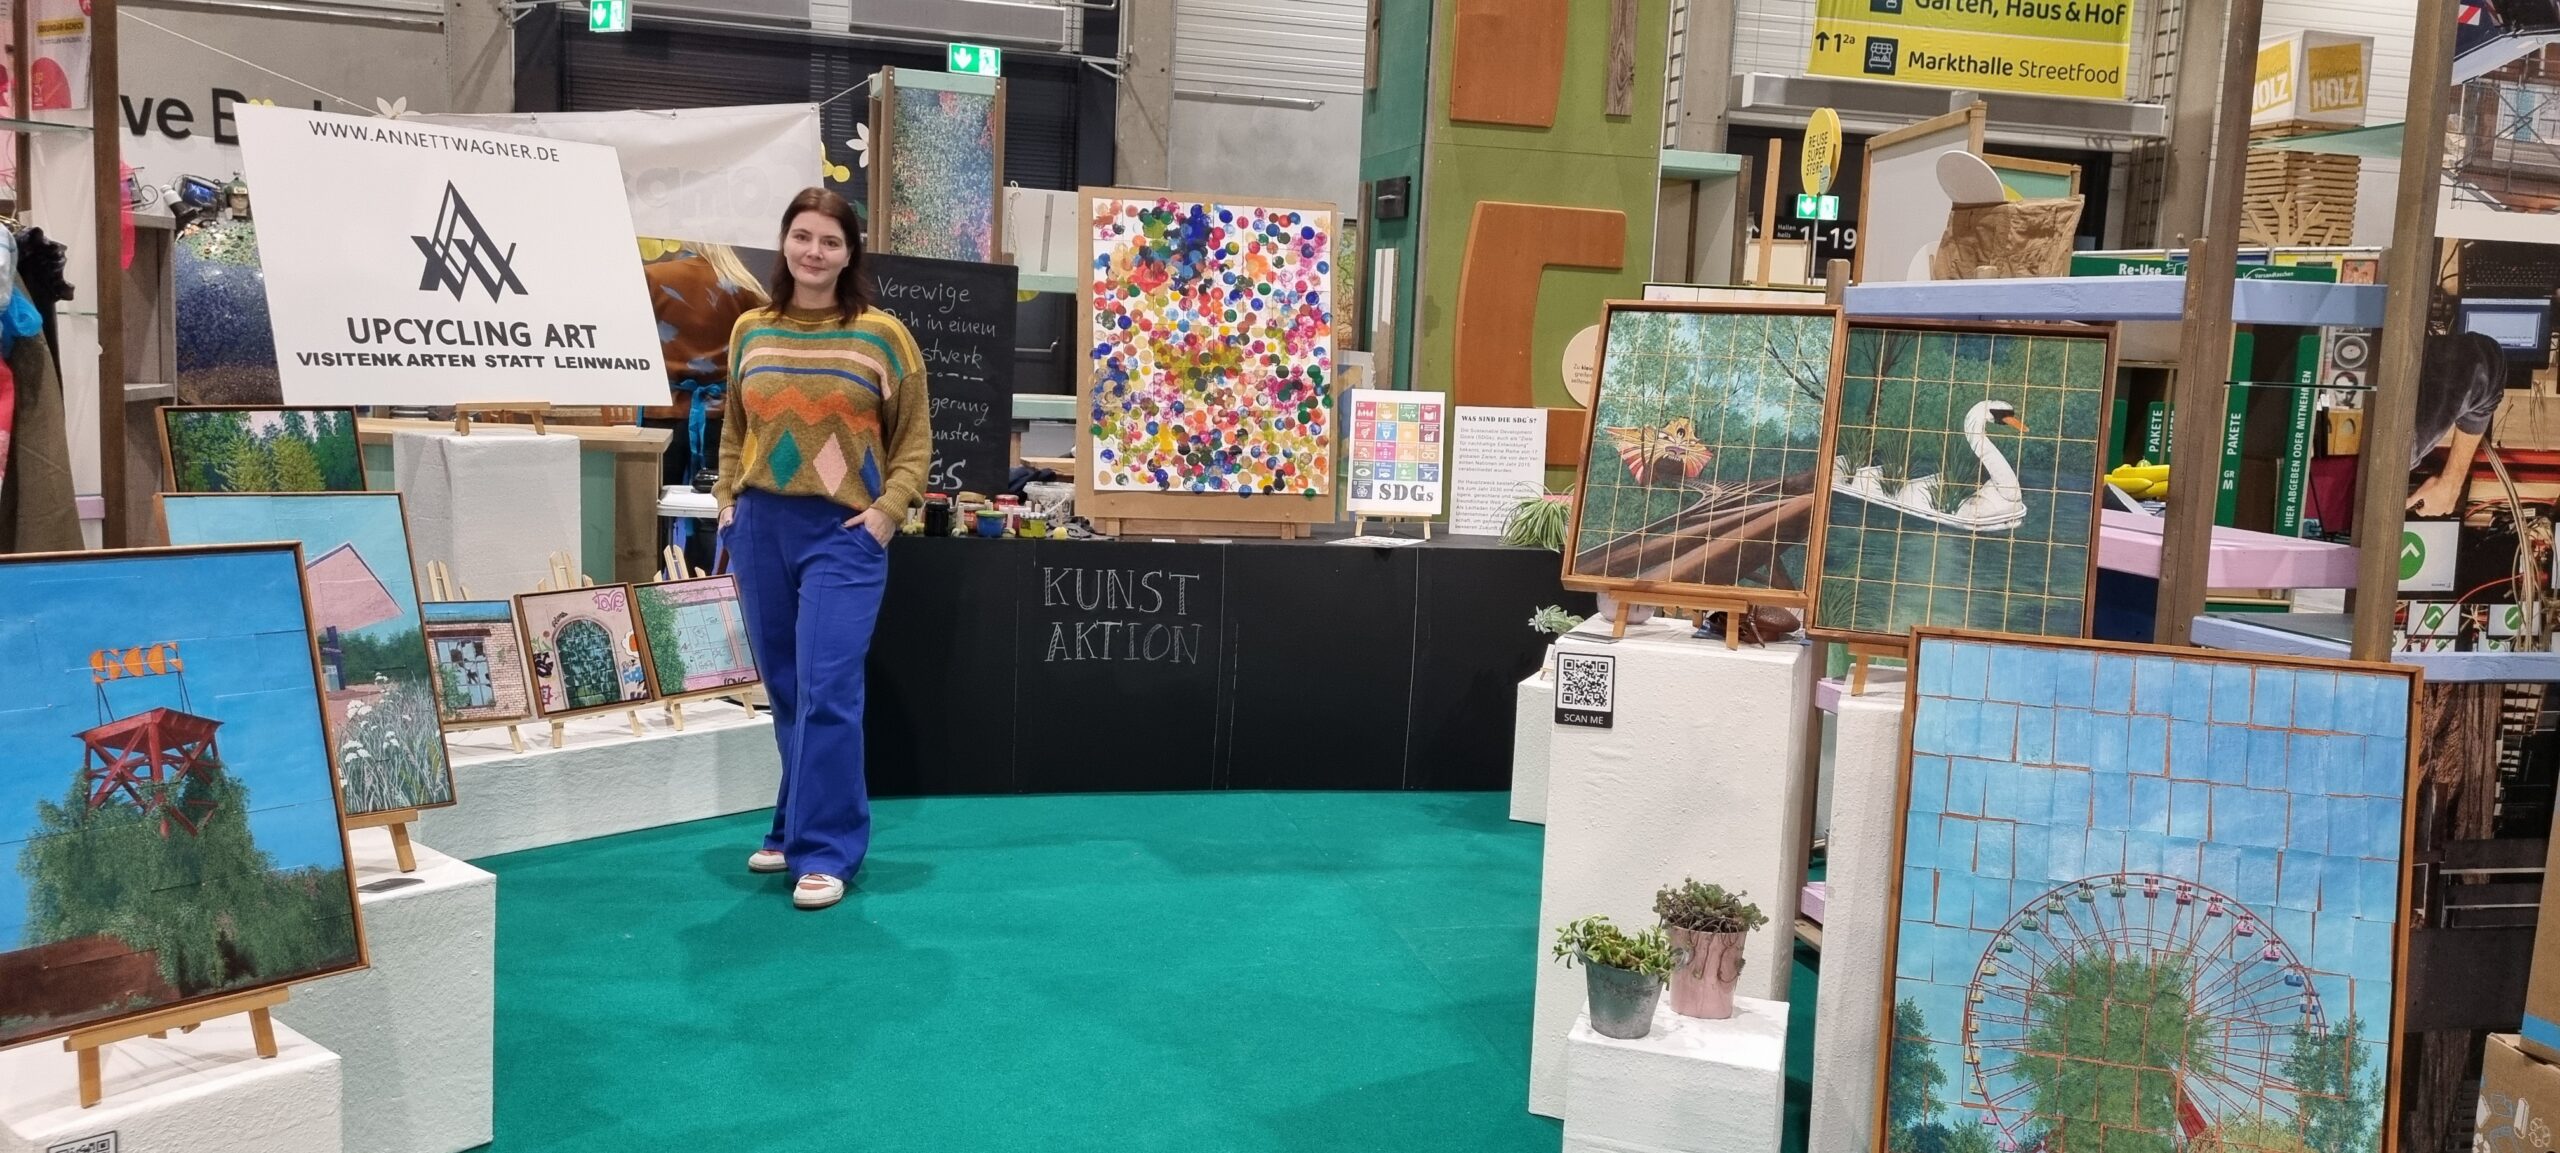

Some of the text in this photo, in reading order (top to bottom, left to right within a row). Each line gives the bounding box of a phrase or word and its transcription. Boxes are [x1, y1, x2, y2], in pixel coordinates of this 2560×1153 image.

[2006, 0, 2062, 22] Haus
[2065, 2, 2081, 22] &
[2085, 3, 2127, 26] Hof
[1908, 50, 2119, 84] Markthalle Streetfood
[2312, 75, 2359, 109] HOLZ
[308, 120, 560, 162] WWW.ANNETTWAGNER.DE
[1807, 146, 1826, 162] SUPER
[1806, 160, 1824, 176] STORE
[2118, 262, 2162, 276] Re-Use
[877, 275, 971, 314] Verewige
[347, 316, 598, 348] UPCYCLING ART
[927, 314, 944, 332] in
[949, 316, 996, 338] einem
[484, 354, 545, 368] STATT
[554, 356, 650, 371] LEINWAND
[920, 338, 983, 370] stwerk
[2149, 410, 2163, 452] PAKETE
[2226, 413, 2241, 455] PAKETE
[2294, 429, 2305, 458] ODER
[928, 458, 967, 490] GS
[2222, 480, 2233, 490] M
[2288, 460, 2301, 503] ABGEBEN
[1379, 483, 1434, 502] SDGs
[2284, 506, 2295, 527] HIER
[1044, 567, 1200, 615] KUNST
[1044, 620, 1202, 664] AKTION
[1564, 714, 1604, 724] SCAN ME
